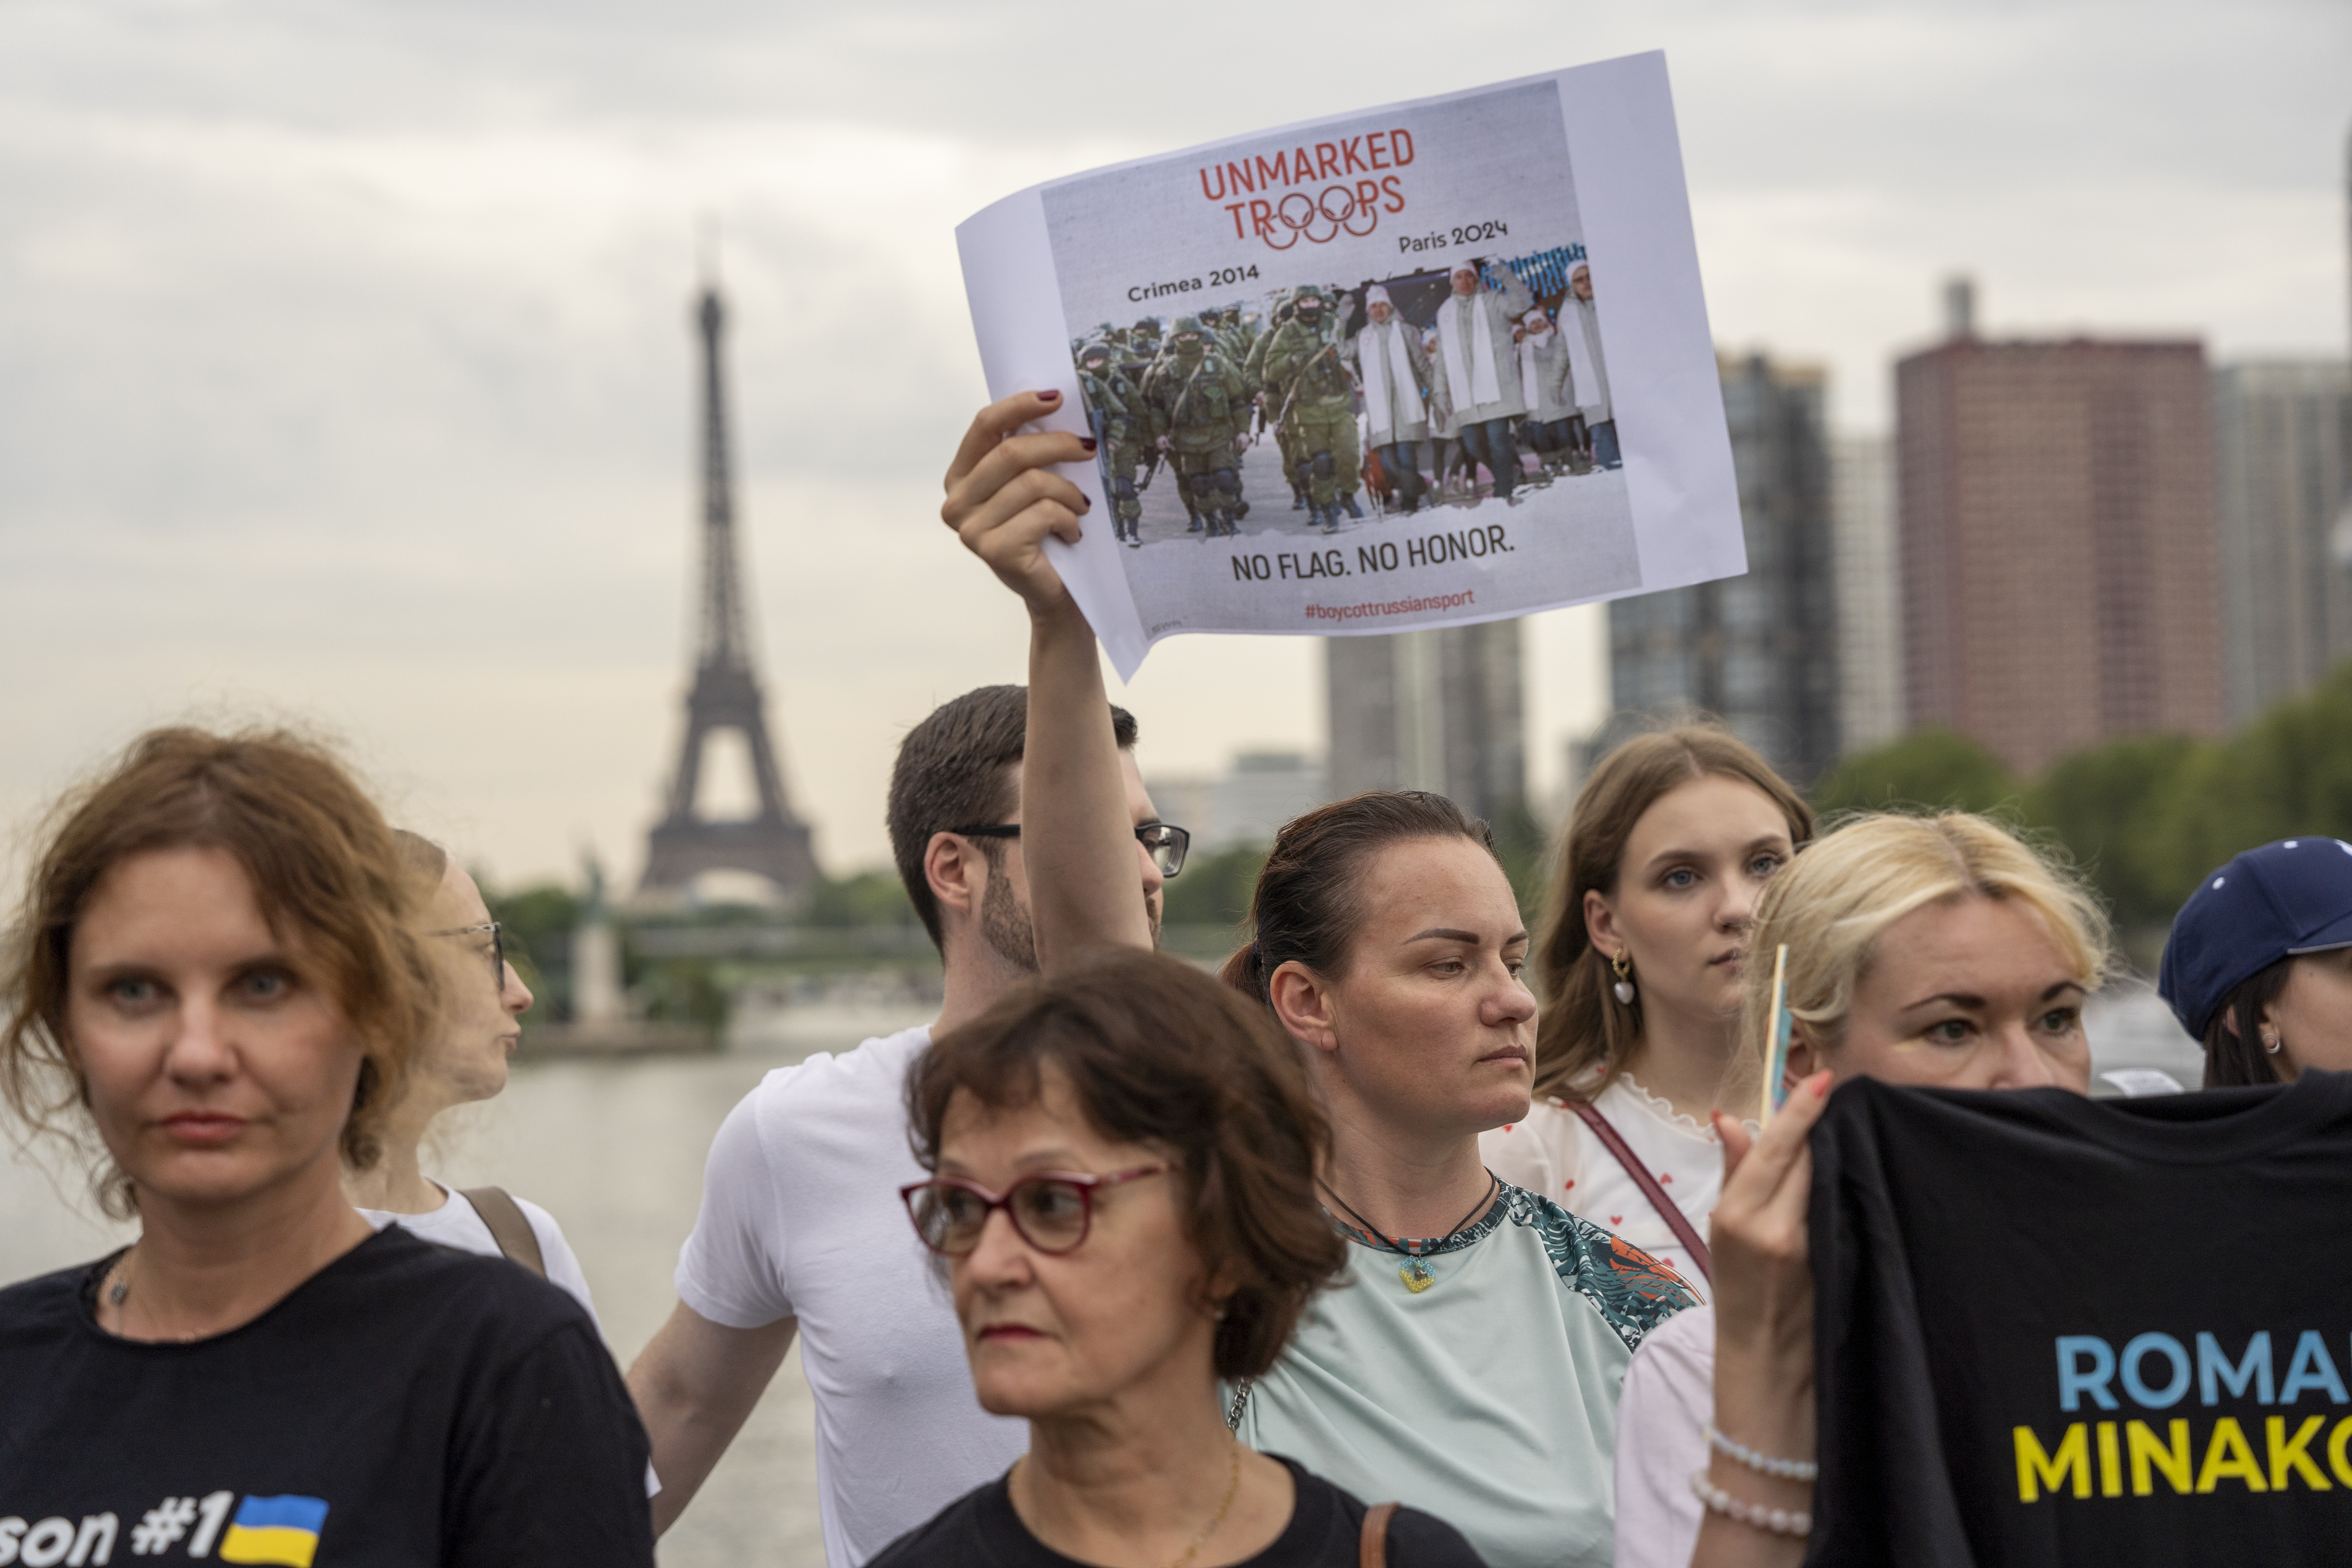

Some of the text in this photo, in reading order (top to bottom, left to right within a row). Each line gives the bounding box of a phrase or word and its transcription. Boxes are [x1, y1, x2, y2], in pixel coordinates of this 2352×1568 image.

[1200, 128, 1414, 200] UNMARKED
[1224, 175, 1405, 250] TROOPS
[1399, 220, 1508, 253] Paris 2024
[1127, 263, 1259, 302] Crimea 2014
[1231, 524, 1515, 581] NO FLAG. NO HONOR.
[1305, 590, 1475, 622] #boycottrussiansport
[2056, 1330, 2352, 1411] ROMA
[131, 1490, 234, 1558] #1
